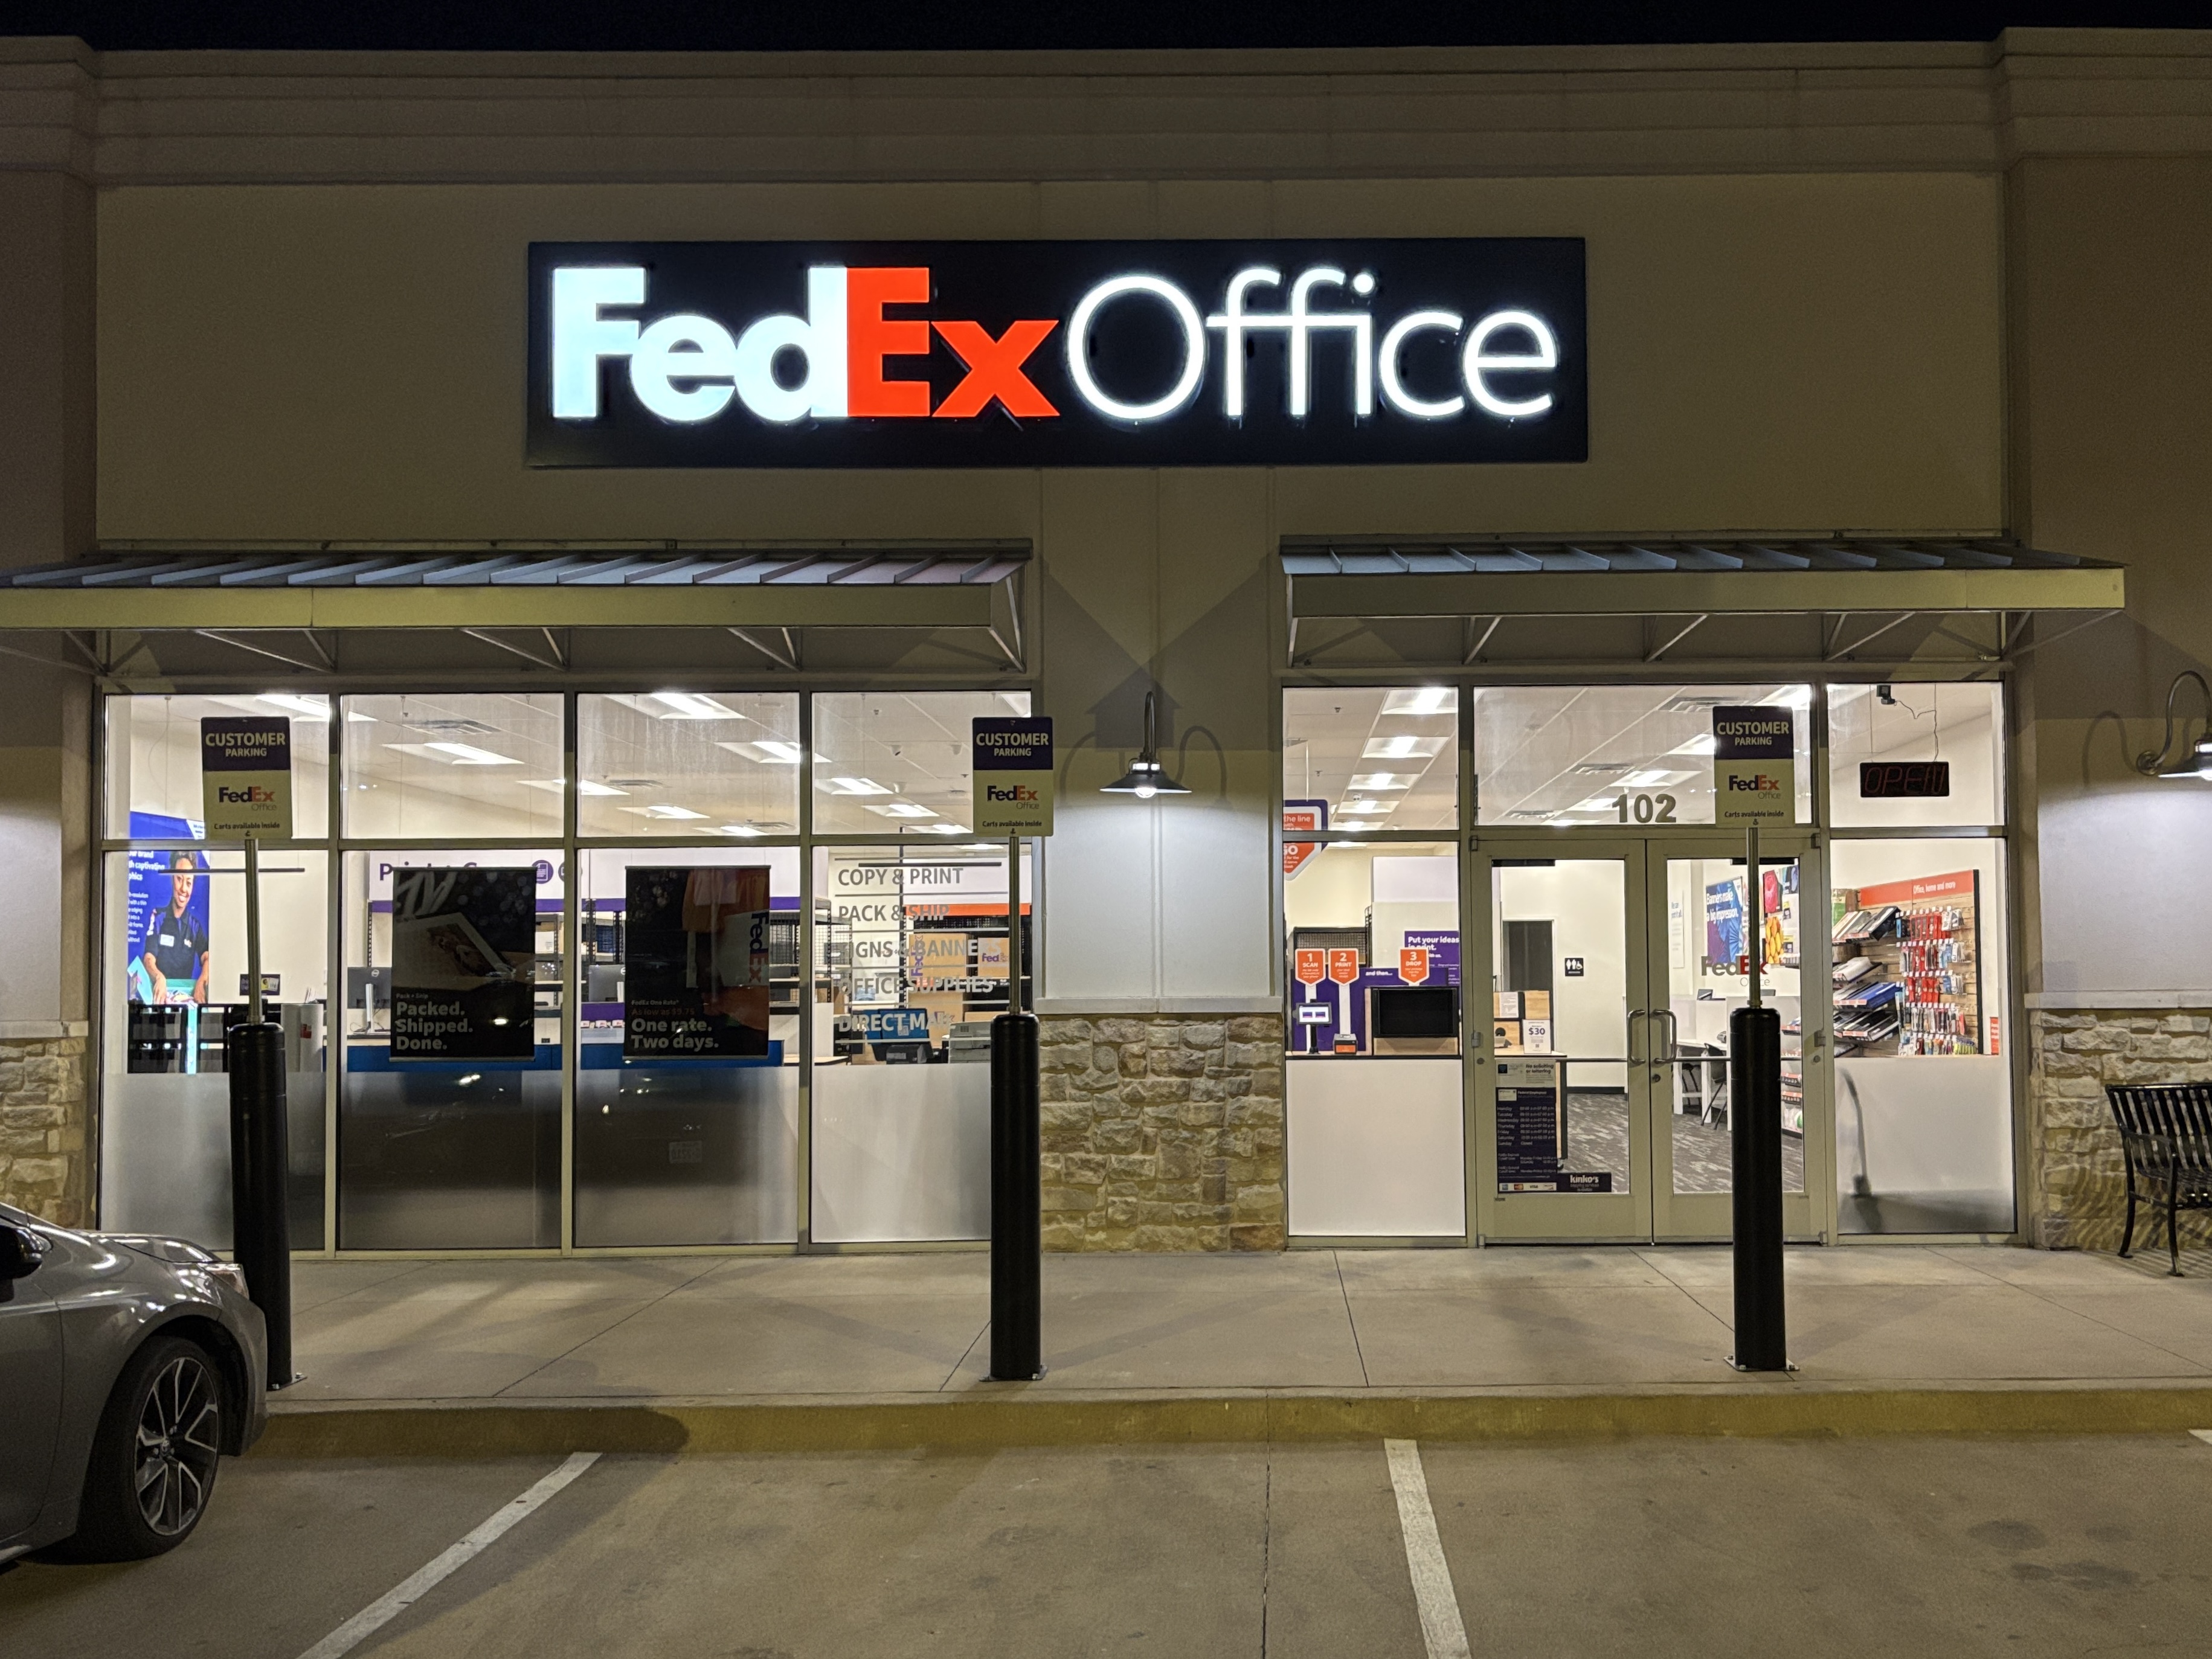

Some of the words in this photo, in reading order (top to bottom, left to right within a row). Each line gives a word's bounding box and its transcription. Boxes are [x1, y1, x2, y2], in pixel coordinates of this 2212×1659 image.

[553, 267, 1060, 423] FedEx
[1066, 269, 1558, 420] Office
[1717, 721, 1789, 735] CUSTOMER
[205, 732, 286, 746] CUSTOMER
[976, 733, 1049, 746] CUSTOMER
[1735, 737, 1772, 746] PARKING
[225, 748, 267, 757] PARKING
[994, 748, 1032, 756] PARKING
[1729, 775, 1780, 791] FedEx
[1865, 766, 1946, 794] OPEN
[219, 786, 275, 803] FedEx
[988, 785, 1038, 801] FedEx
[1612, 794, 1676, 823] 102
[838, 869, 887, 886] COPY
[892, 868, 904, 884] &
[910, 868, 963, 885] PRINT
[839, 905, 887, 922] PACK
[891, 905, 904, 921] &
[908, 904, 950, 921] SHIP
[749, 911, 769, 983] FedEx
[839, 941, 893, 959] IGNS
[898, 940, 909, 958] &
[915, 939, 1002, 957] BANNERS
[1307, 953, 1313, 961] 1
[1340, 952, 1347, 961] 2
[1410, 952, 1417, 961] 3
[840, 977, 904, 994] OFFICE
[908, 976, 994, 993] SUPPLIES
[396, 1001, 466, 1015] Packed.
[395, 1018, 474, 1036] Shipped.
[631, 1018, 667, 1032] One
[672, 1018, 712, 1032] rate.
[839, 1013, 906, 1032] DIRECT
[396, 1036, 448, 1050] Done.
[631, 1034, 669, 1048] Two
[673, 1033, 719, 1052] days.
[1570, 1175, 1600, 1184] kinko's
